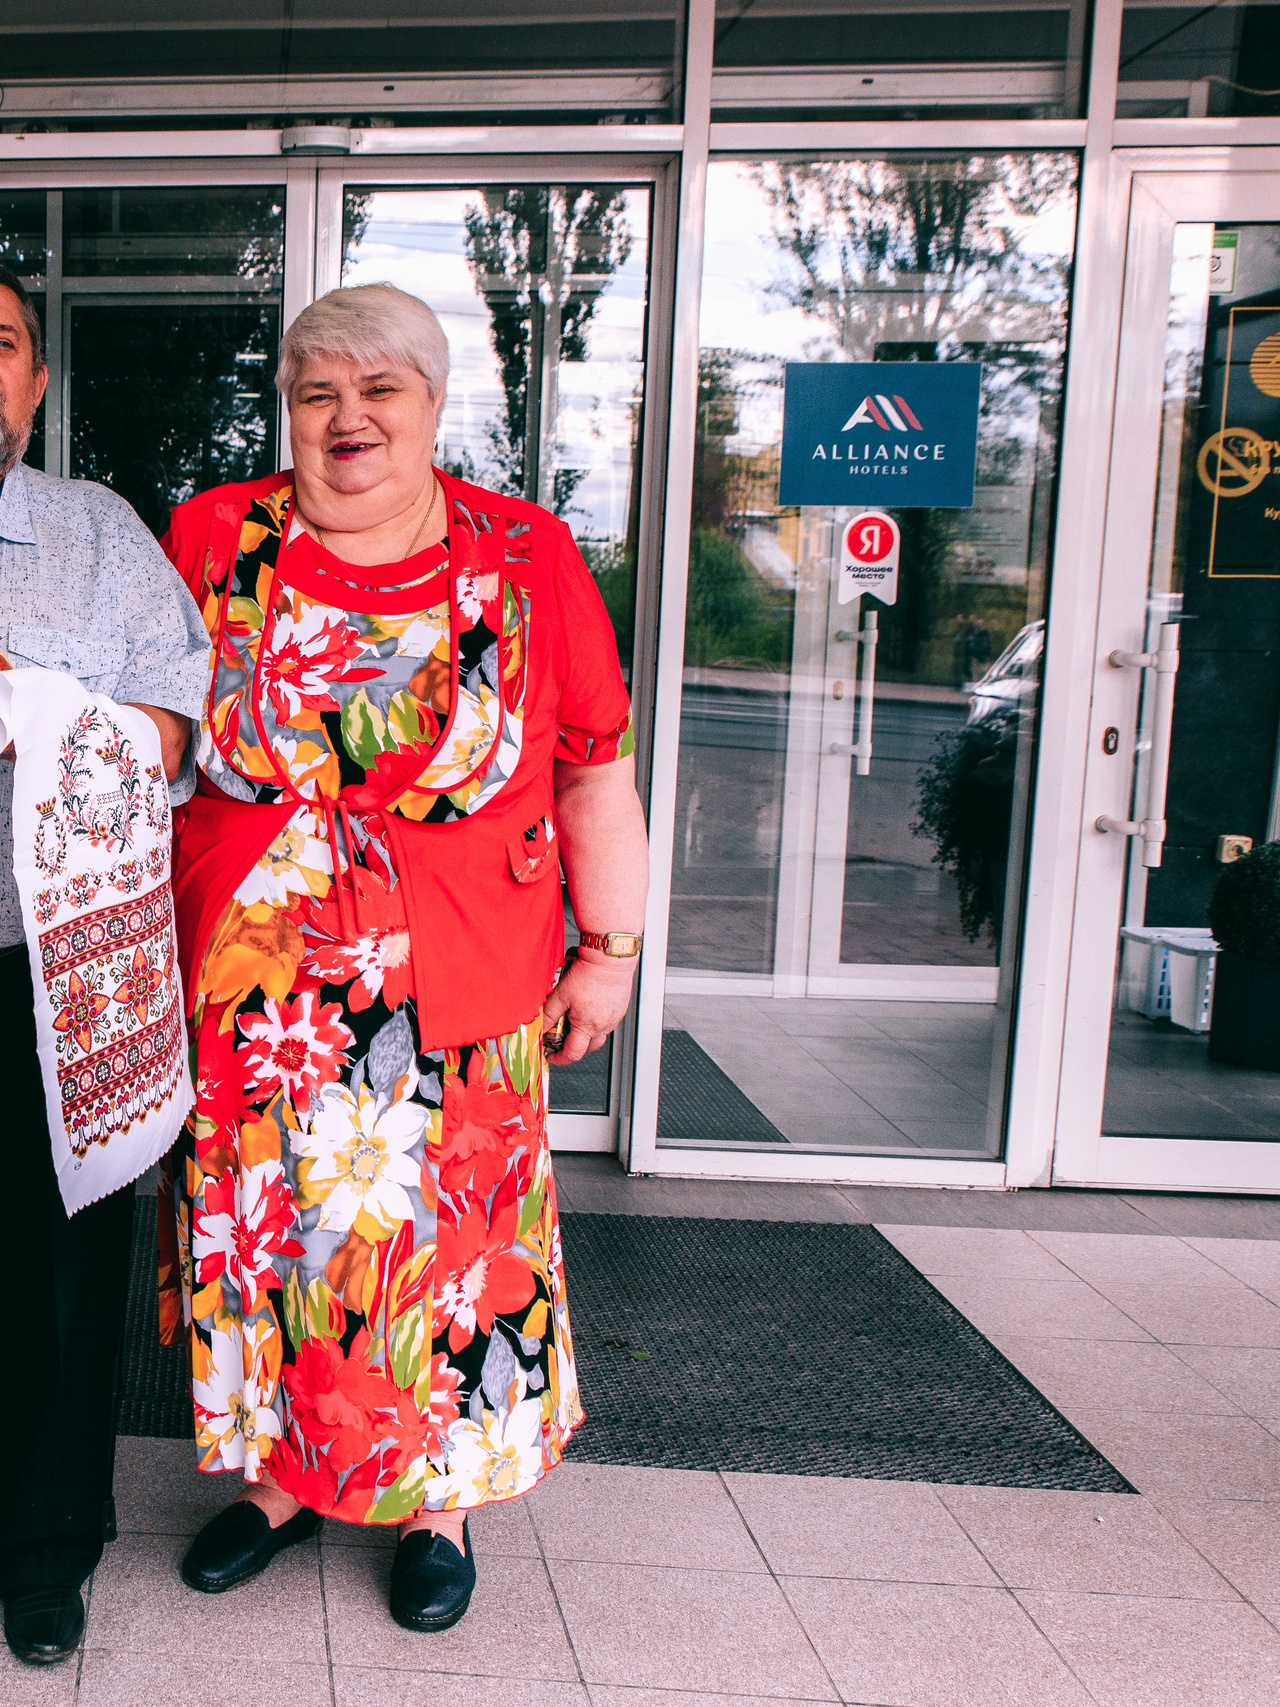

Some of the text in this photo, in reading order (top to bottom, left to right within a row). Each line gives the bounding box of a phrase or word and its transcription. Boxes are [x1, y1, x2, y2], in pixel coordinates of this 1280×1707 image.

[812, 444, 946, 460] ALLIANCE
[849, 465, 908, 475] HOTELS
[858, 525, 880, 555] Я
[845, 565, 893, 573] Хорошее
